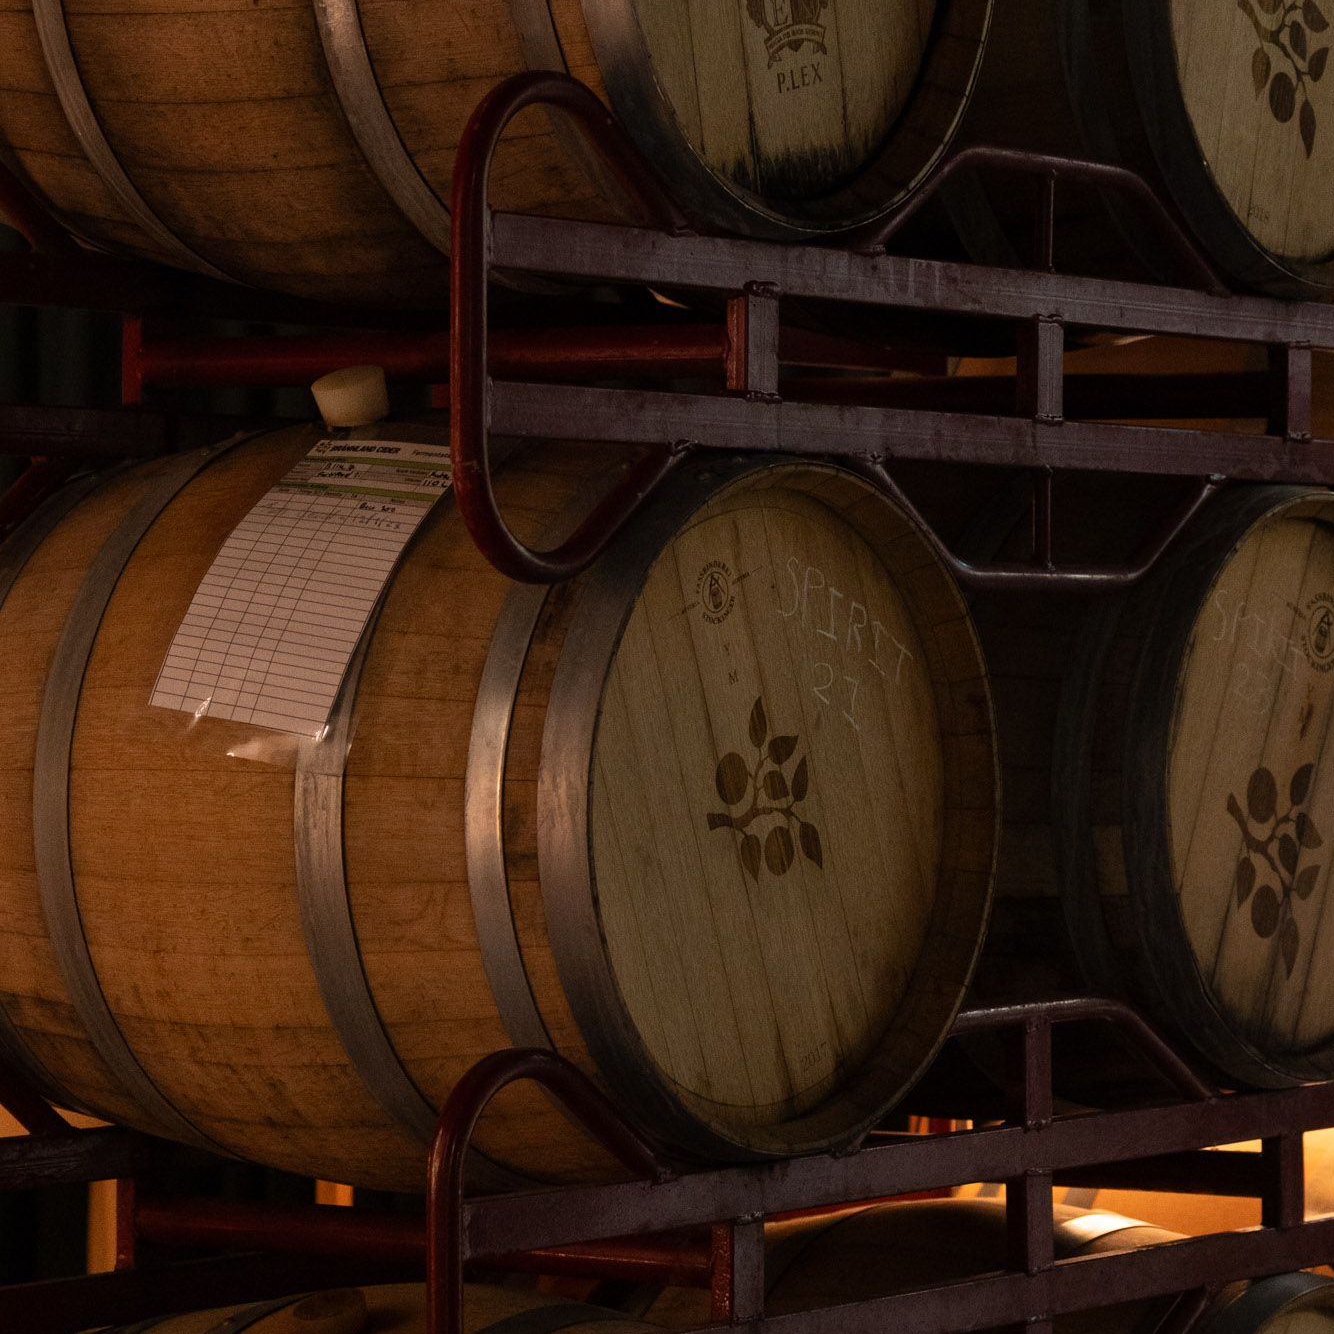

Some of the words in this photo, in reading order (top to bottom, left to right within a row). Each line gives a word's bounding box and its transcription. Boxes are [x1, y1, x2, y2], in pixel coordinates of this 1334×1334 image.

[777, 62, 823, 94] P.LEX
[376, 446, 401, 454] CIDER
[777, 556, 913, 684] SPIRIT
[727, 670, 740, 686] M
[801, 1042, 830, 1073] 2017
